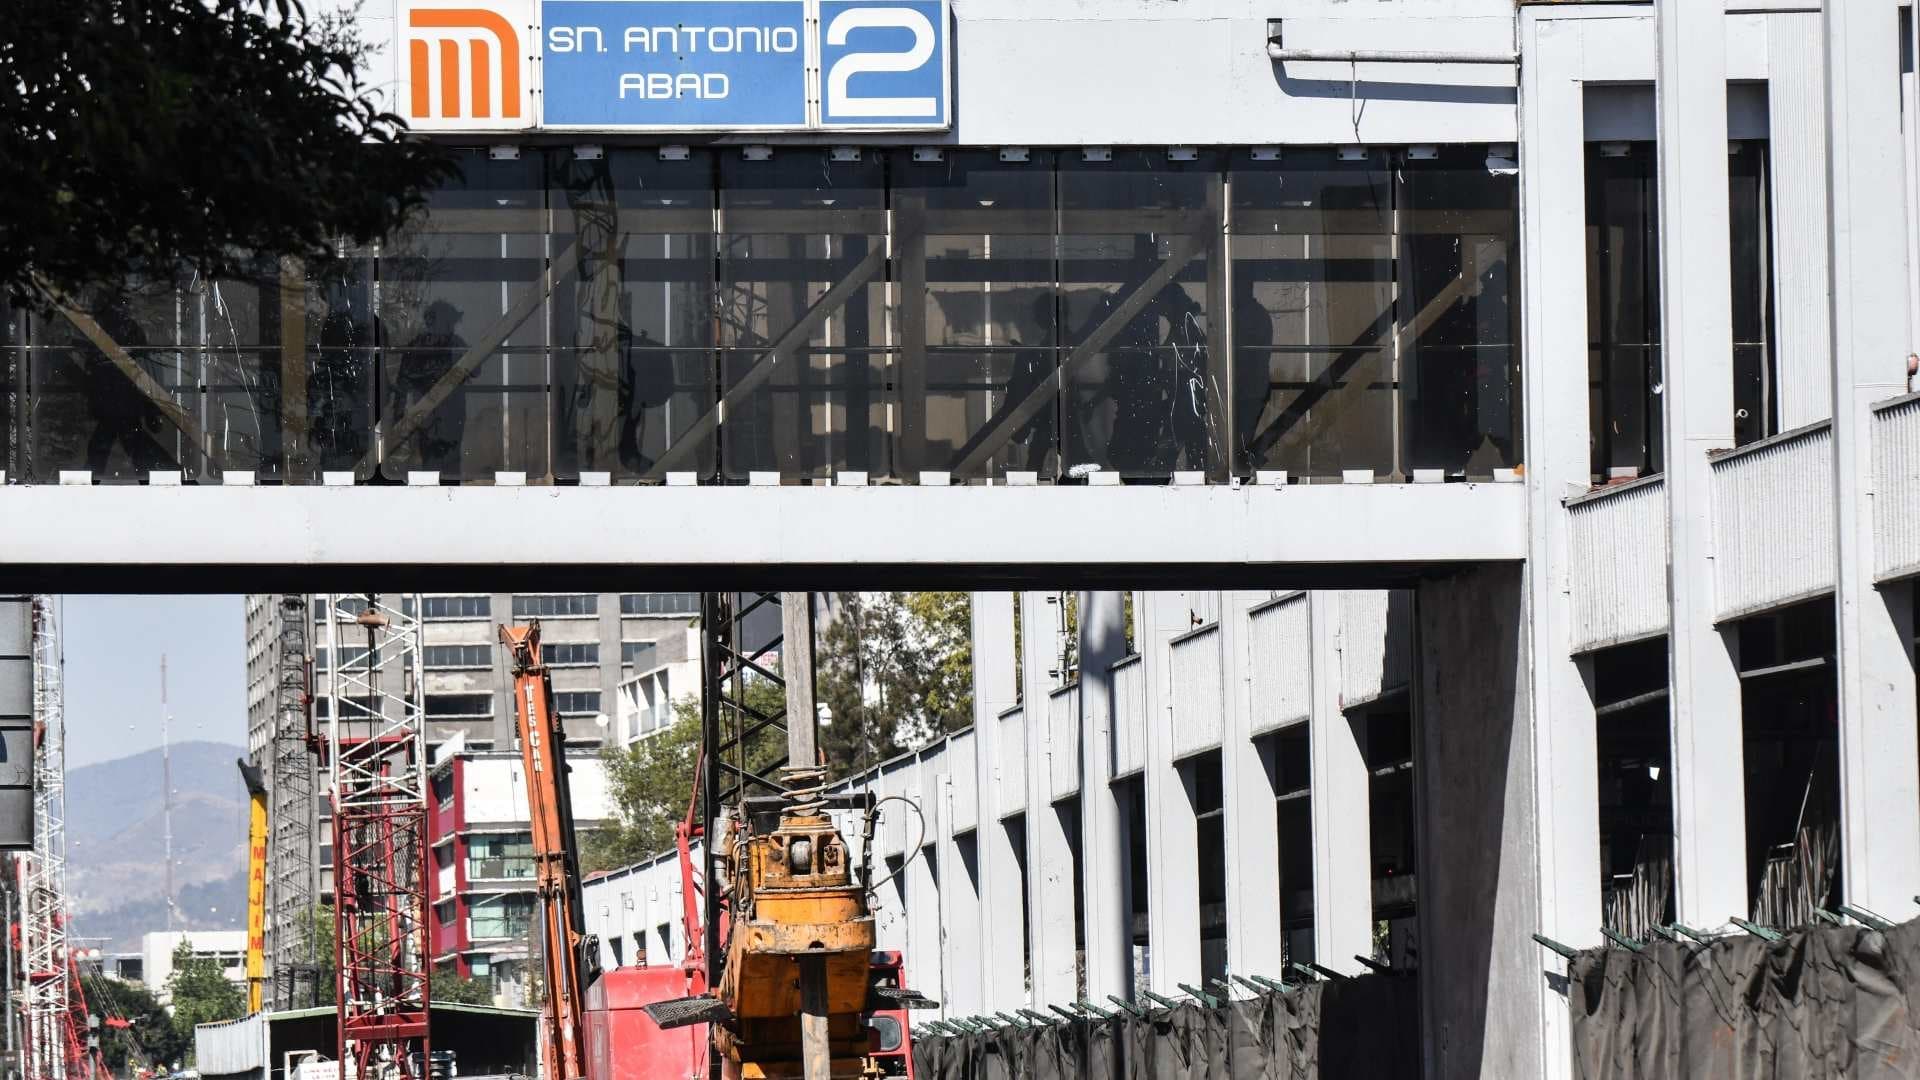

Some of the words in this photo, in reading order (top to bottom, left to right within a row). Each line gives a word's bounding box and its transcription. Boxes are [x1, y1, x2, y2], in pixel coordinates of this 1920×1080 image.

[618, 73, 730, 99] ABAD
[826, 7, 937, 117] 2
[251, 846, 266, 950] MAJIM
